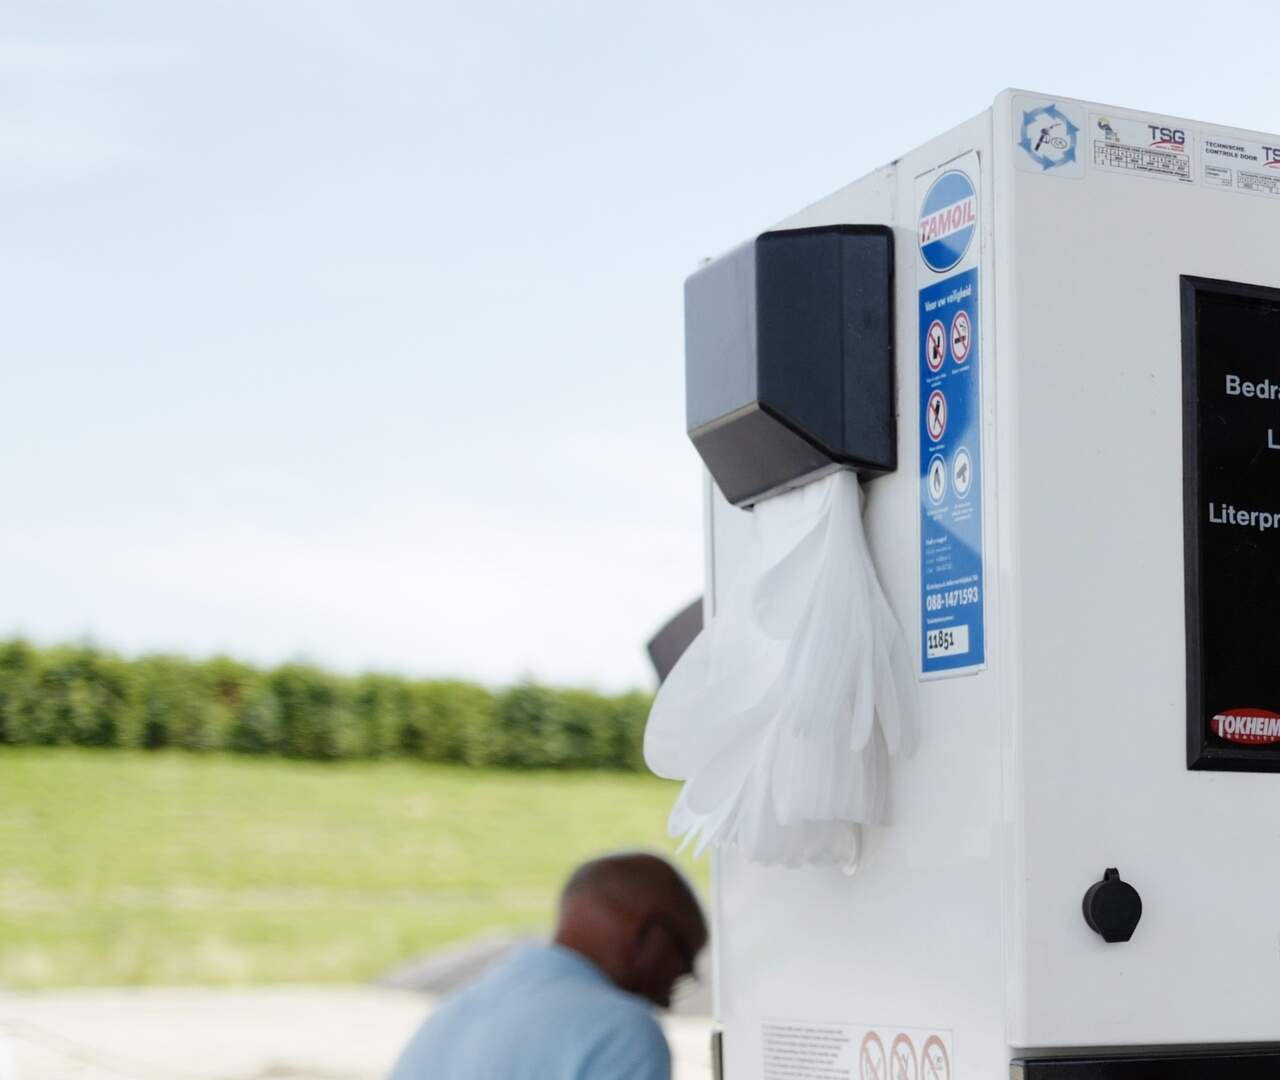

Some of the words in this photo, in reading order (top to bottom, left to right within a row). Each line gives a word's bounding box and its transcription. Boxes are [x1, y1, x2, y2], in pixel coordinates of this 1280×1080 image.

[1148, 125, 1185, 145] TSG
[920, 199, 976, 243] TAMOIL
[928, 630, 954, 651] 11851
